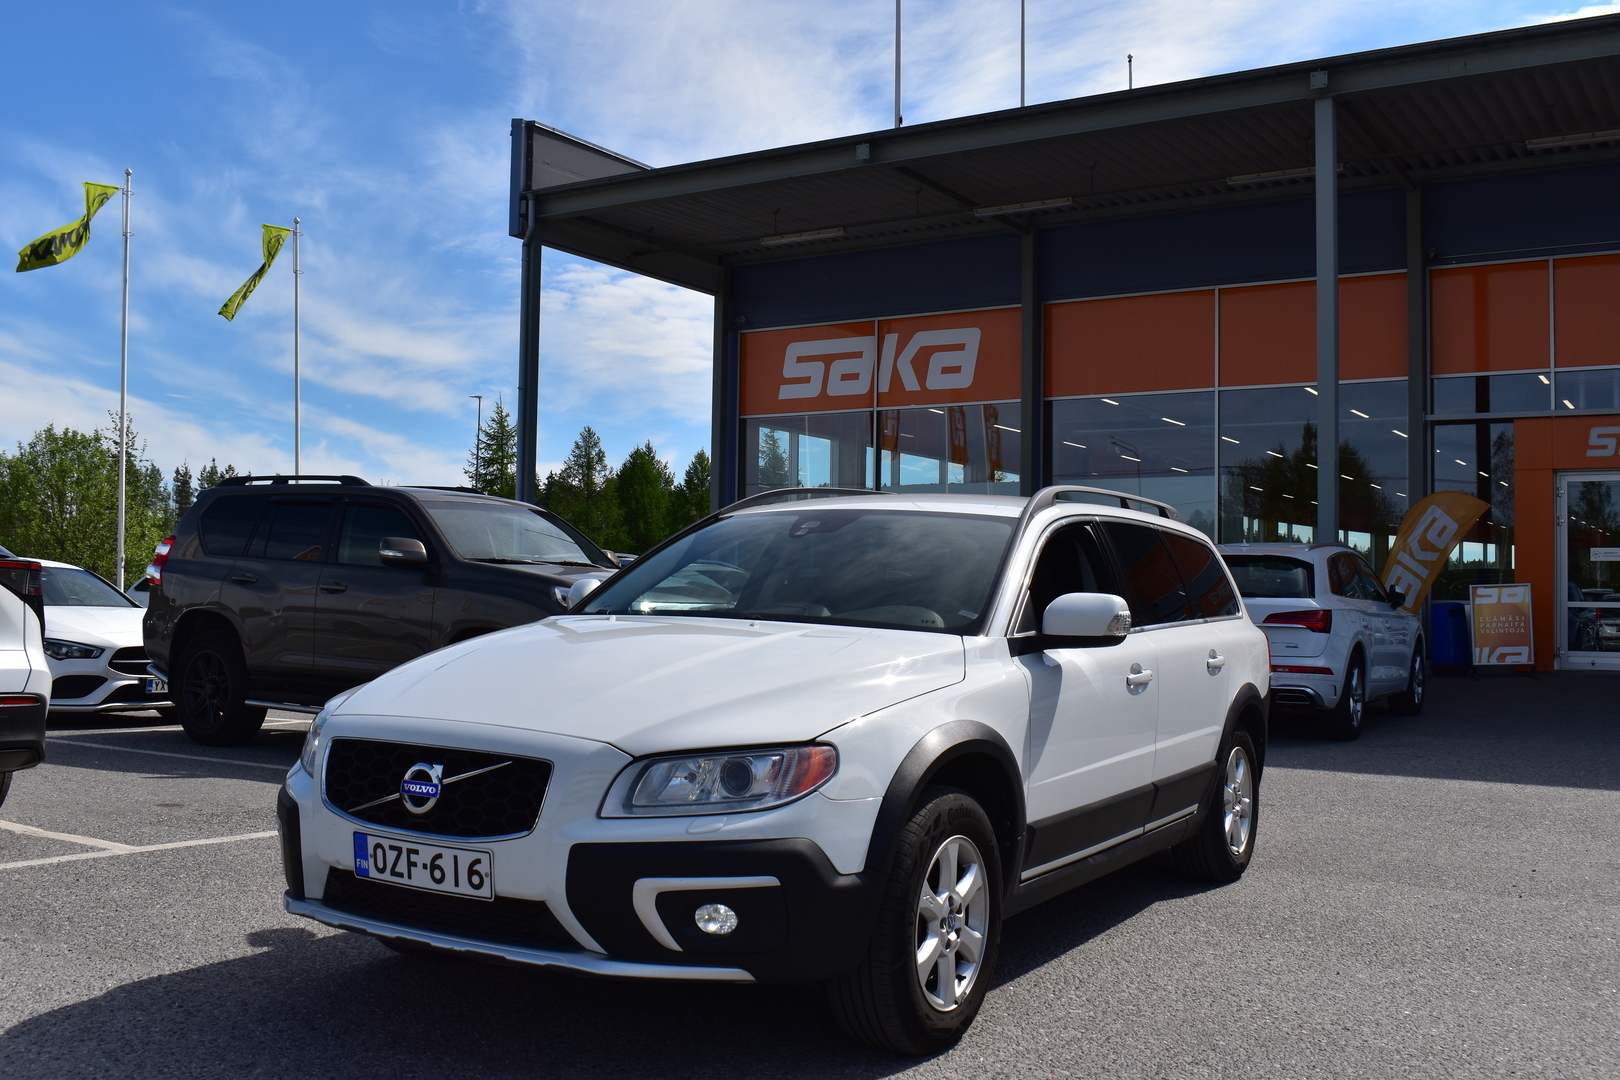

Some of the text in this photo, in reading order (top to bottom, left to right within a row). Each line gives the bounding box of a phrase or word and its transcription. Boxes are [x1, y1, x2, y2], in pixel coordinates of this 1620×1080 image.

[404, 783, 436, 794] VOLVO
[356, 858, 369, 870] FIN
[373, 842, 485, 891] OZF-616
